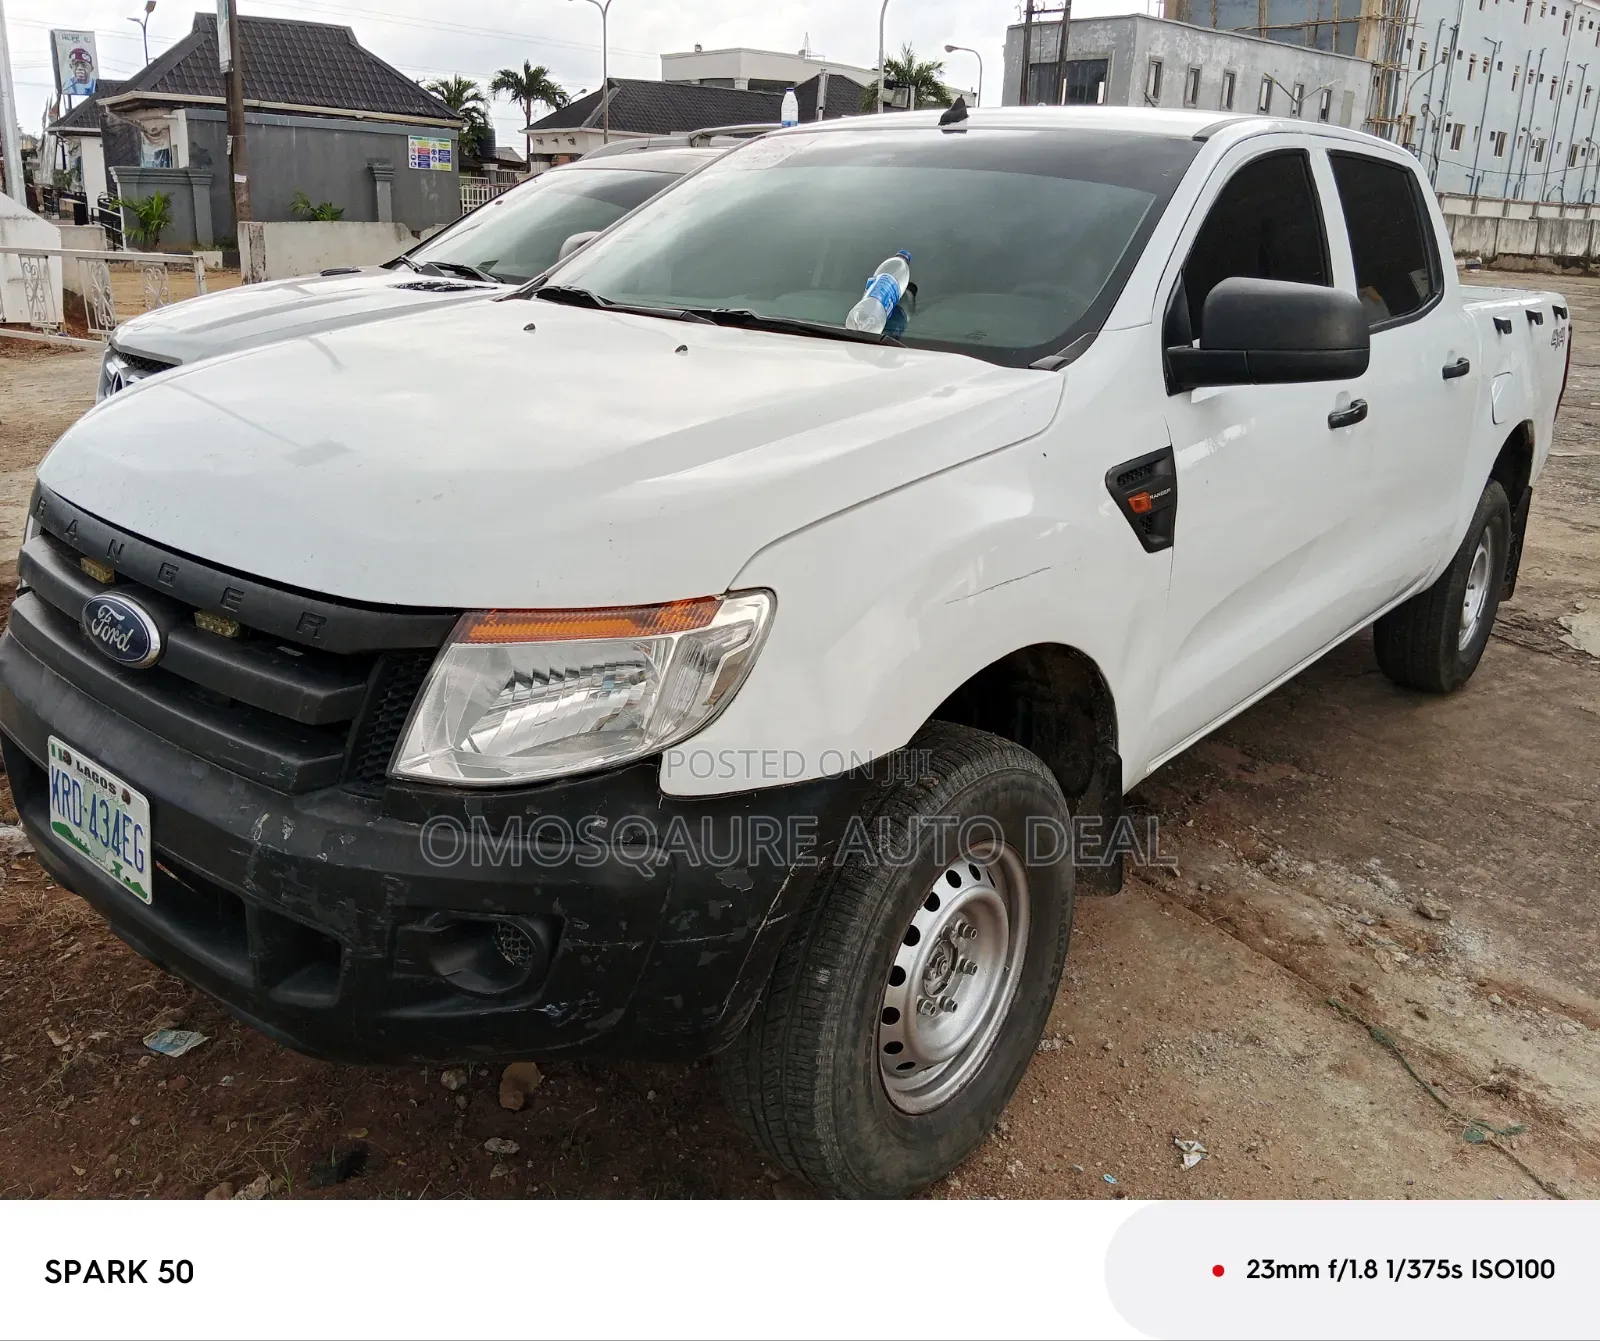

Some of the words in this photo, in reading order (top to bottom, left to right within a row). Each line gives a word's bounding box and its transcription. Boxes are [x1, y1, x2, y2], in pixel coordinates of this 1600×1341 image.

[1149, 487, 1172, 500] RANGER
[34, 494, 328, 641] RANGER
[91, 604, 135, 652] Ford
[76, 759, 117, 796] LAGOS
